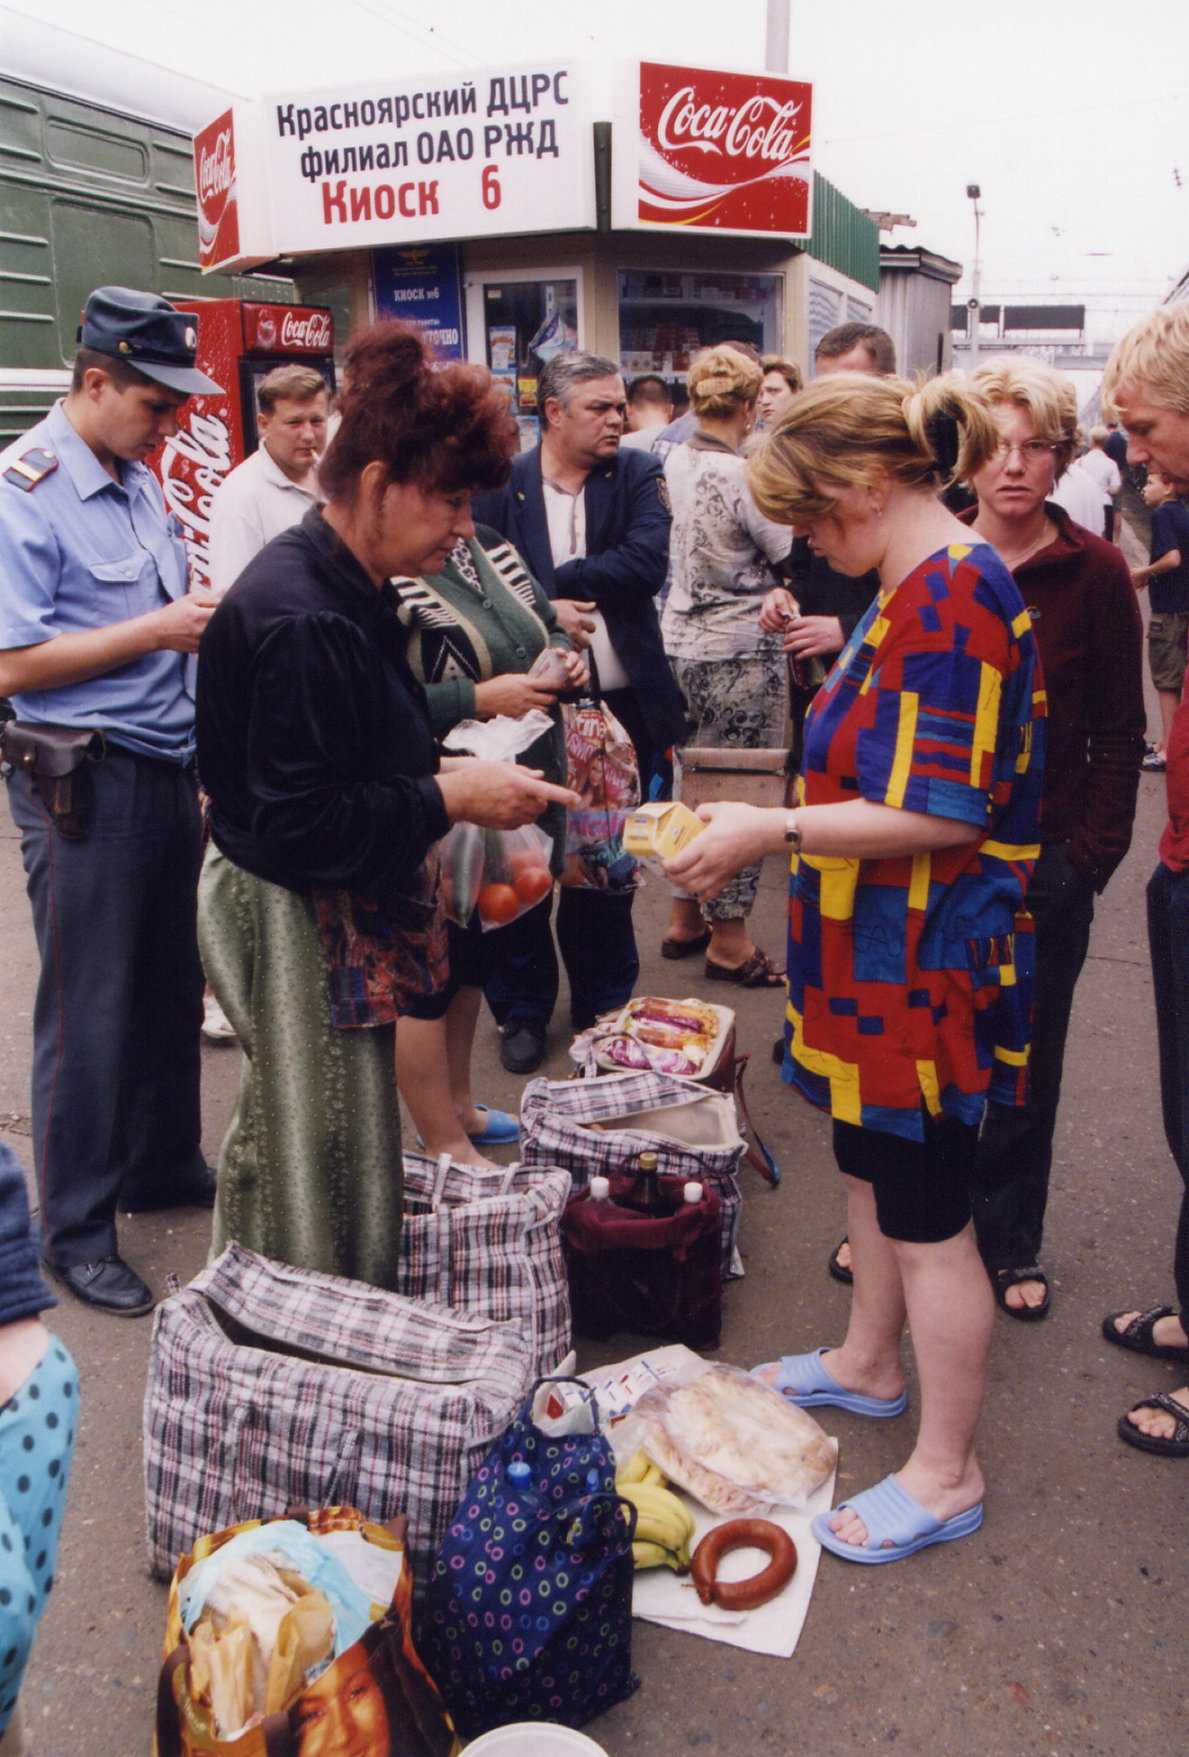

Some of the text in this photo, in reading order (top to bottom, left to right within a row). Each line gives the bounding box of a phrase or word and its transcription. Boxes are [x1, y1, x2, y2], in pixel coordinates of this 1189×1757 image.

[277, 71, 569, 141] Красноярский ДЦРС
[301, 119, 559, 183] филиал ОАО РЖД
[322, 164, 502, 225] Киоск 6
